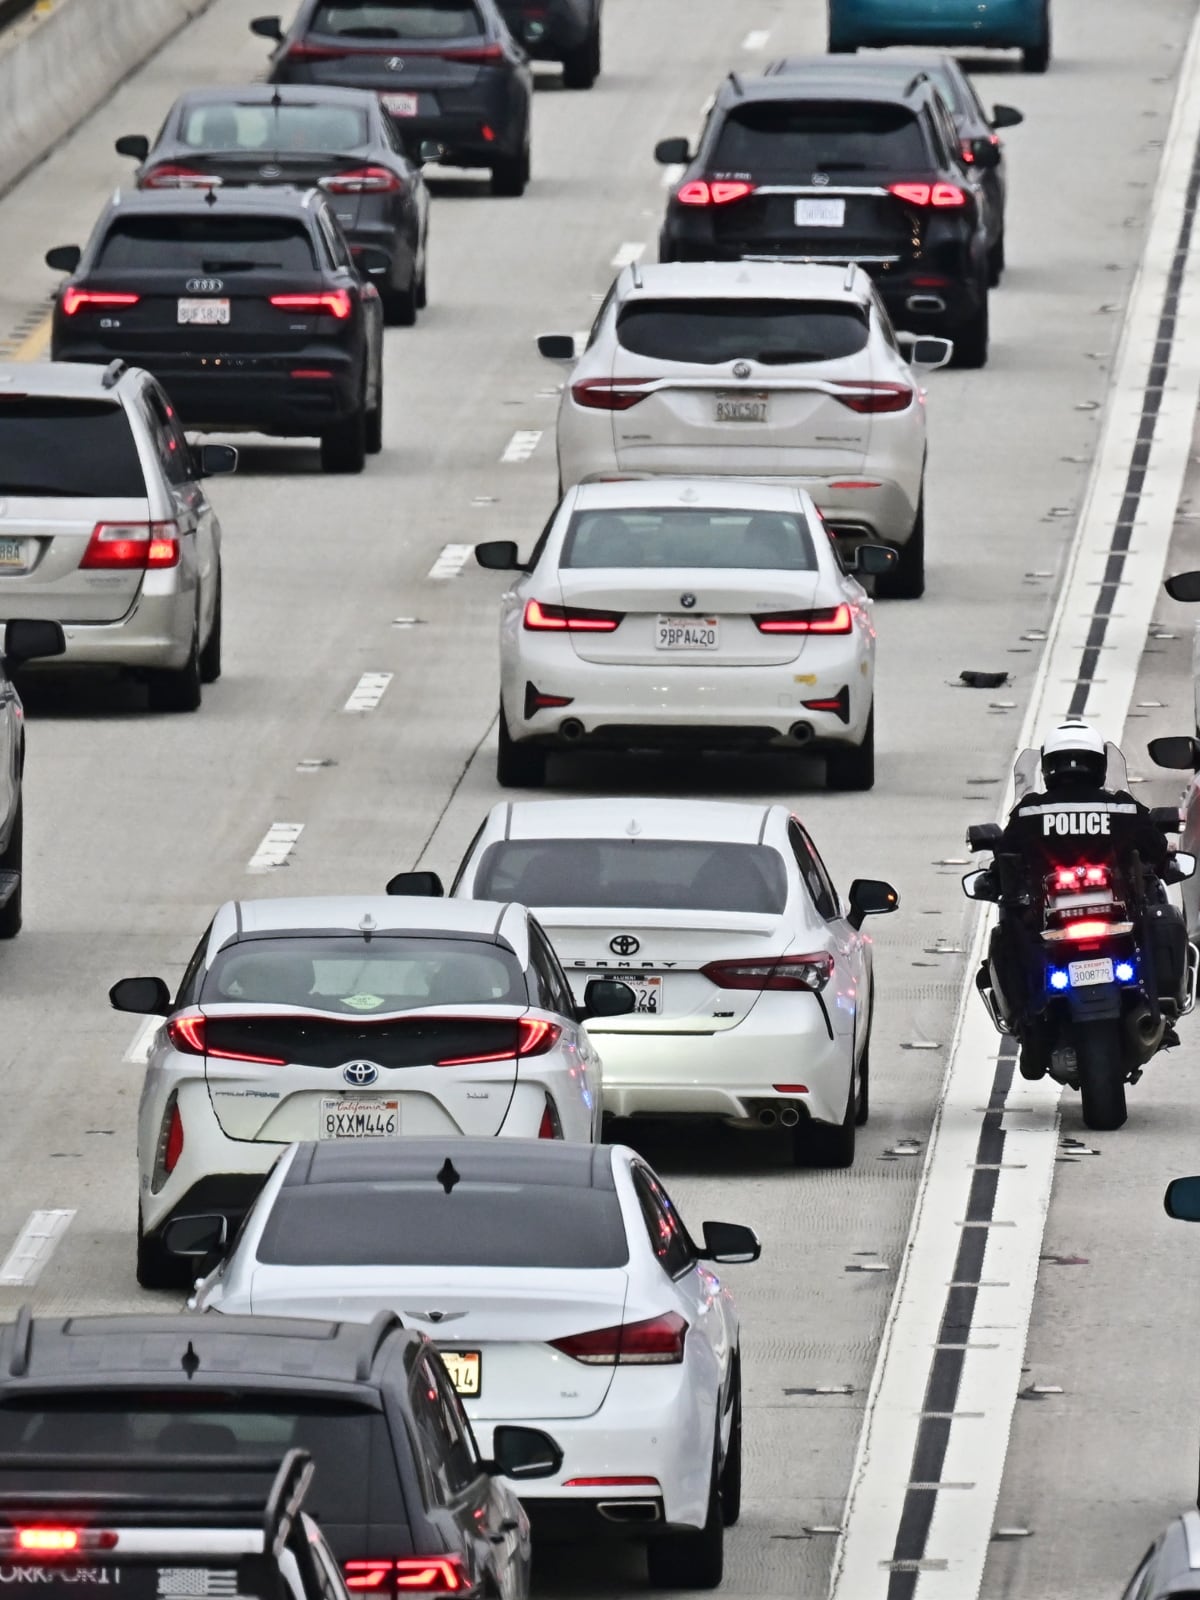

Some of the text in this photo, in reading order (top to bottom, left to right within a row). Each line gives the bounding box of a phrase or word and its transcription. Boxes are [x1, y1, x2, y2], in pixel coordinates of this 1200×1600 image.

[659, 628, 716, 646] 9BPA420
[1043, 812, 1111, 835] POLICE
[336, 1101, 386, 1114] California
[326, 1114, 395, 1133] 8XXM446
